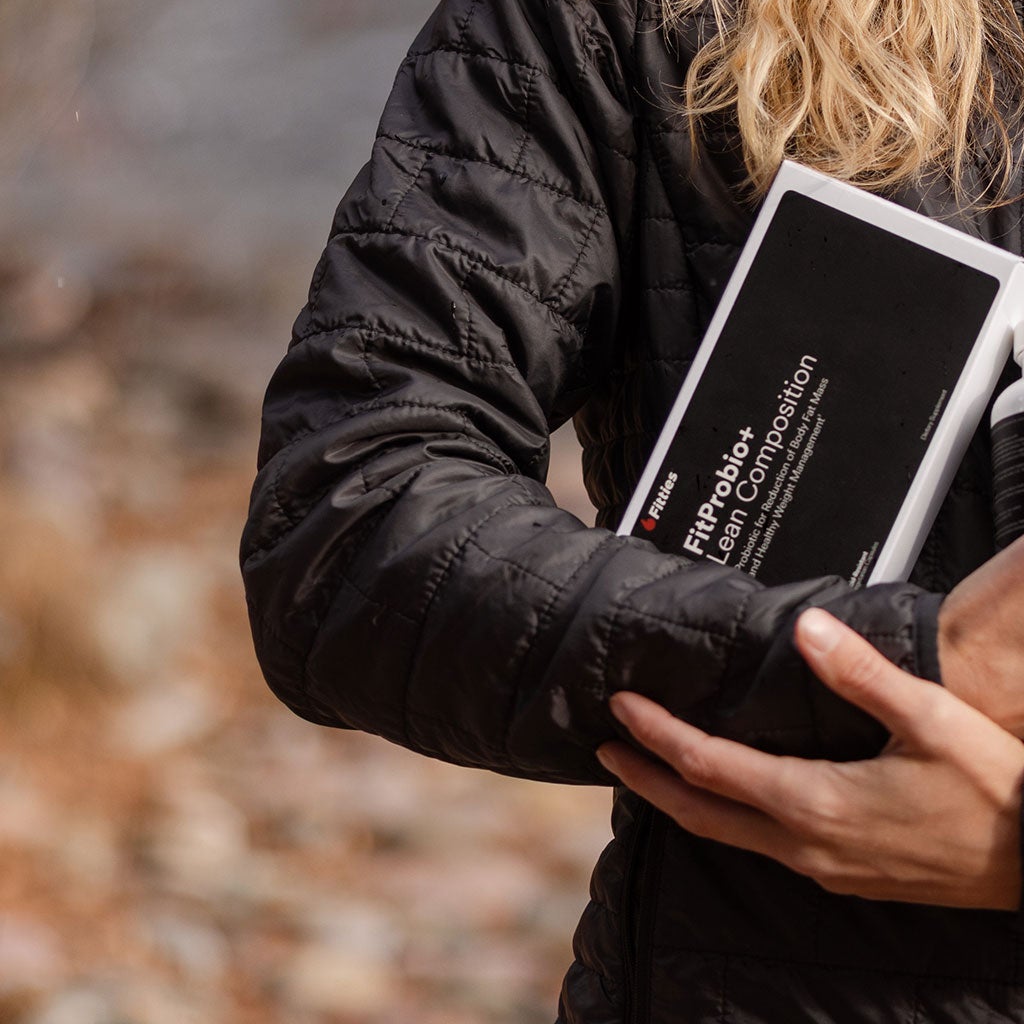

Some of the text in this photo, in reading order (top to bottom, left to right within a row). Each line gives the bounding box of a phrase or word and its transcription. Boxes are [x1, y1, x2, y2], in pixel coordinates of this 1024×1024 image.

[810, 378, 829, 405] Mass
[802, 405, 816, 422] Fat
[786, 449, 795, 462] of
[790, 423, 807, 450] Body
[706, 354, 818, 565] Lean Composition
[648, 471, 678, 520] Fitties
[683, 426, 755, 556] FitProbio+
[761, 462, 790, 513] Reduction
[754, 513, 767, 529] for
[755, 519, 780, 559] Healthy
[773, 483, 796, 519] Weight
